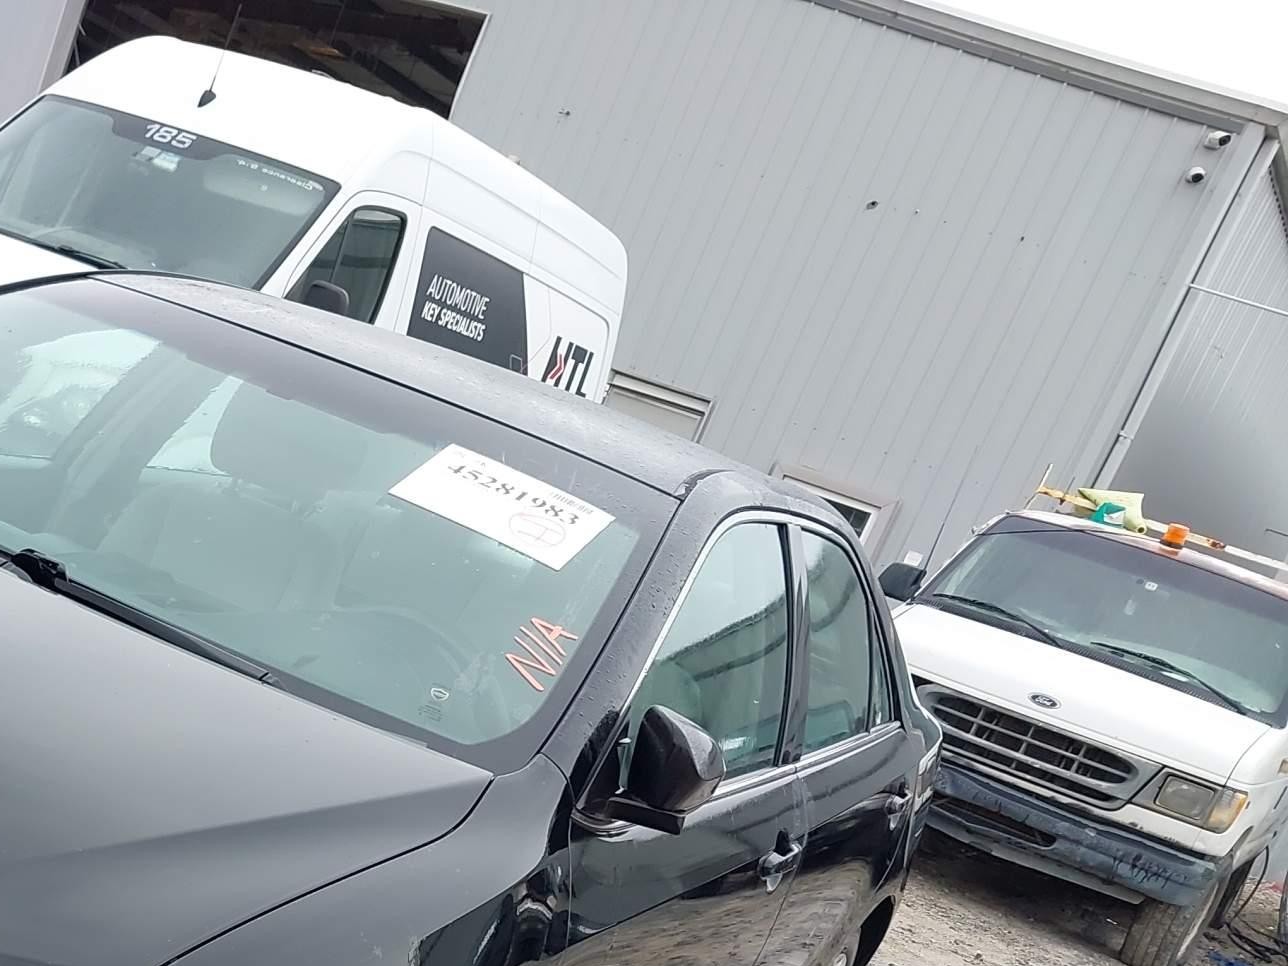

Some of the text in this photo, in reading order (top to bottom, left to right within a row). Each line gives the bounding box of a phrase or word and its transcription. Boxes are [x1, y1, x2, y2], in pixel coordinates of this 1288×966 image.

[143, 123, 198, 149] 185
[426, 274, 490, 320] AUTOMOTIVE
[421, 301, 487, 342] KEY SPECIALISTS
[447, 464, 580, 525] 45281983
[505, 617, 578, 691] N/A
